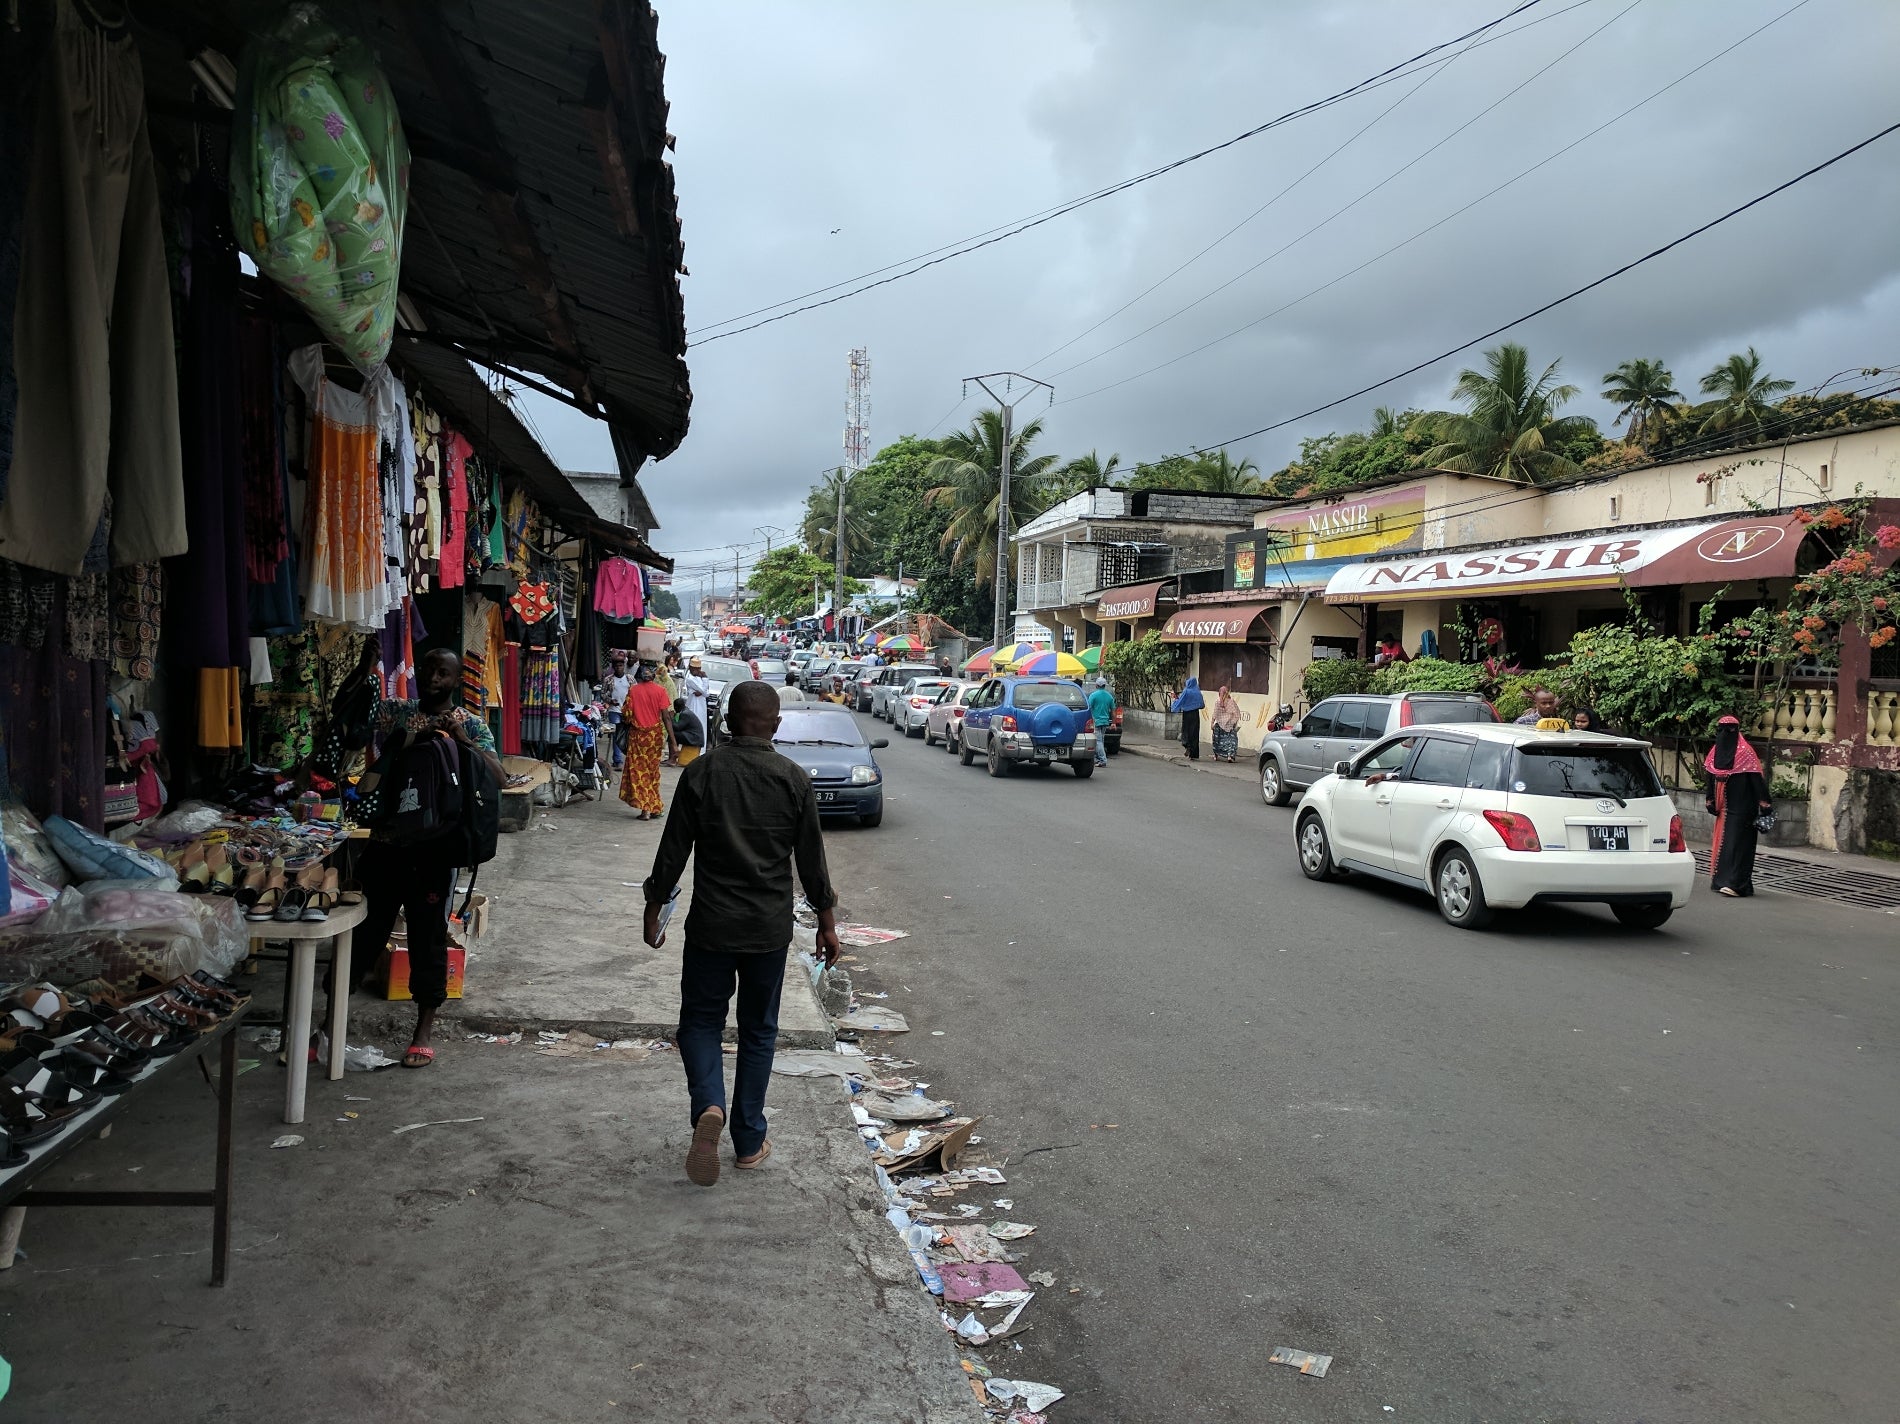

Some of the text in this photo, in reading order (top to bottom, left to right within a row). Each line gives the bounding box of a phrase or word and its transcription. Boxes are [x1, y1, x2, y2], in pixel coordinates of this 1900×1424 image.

[1308, 504, 1368, 540] NASSIB
[1367, 540, 1642, 585] NASSIB
[1175, 621, 1226, 636] NASSIB
[825, 792, 834, 800] 73
[1591, 826, 1626, 838] 170 AR
[1603, 838, 1617, 850] 73
